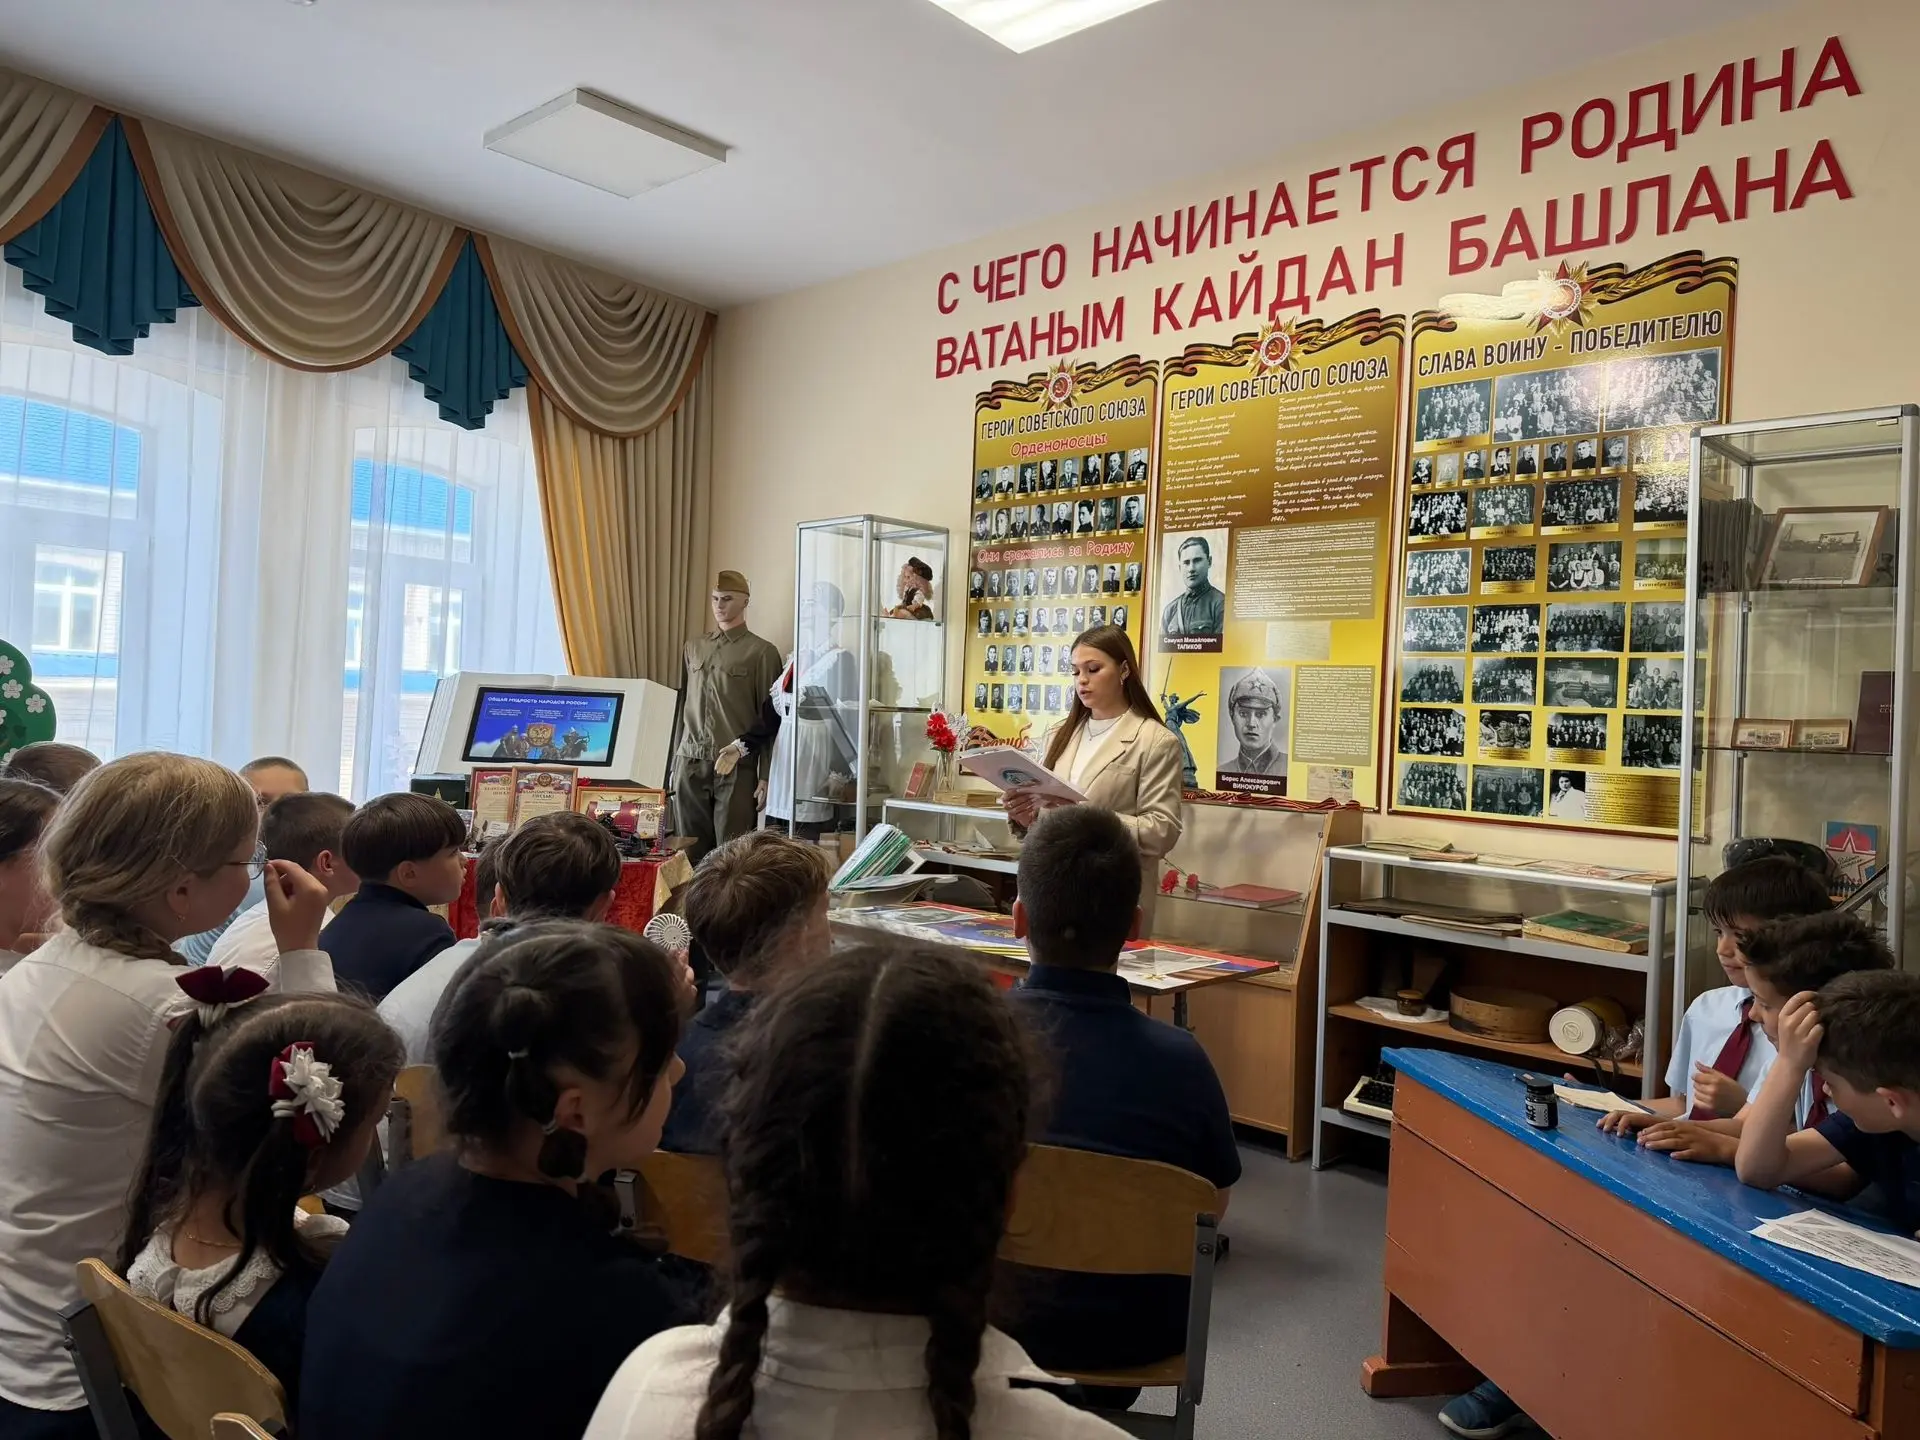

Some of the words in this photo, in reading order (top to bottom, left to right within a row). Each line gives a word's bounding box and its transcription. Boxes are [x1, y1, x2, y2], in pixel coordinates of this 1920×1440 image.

[939, 273, 959, 315] С
[974, 244, 1066, 303] ЧЕГО
[1093, 133, 1475, 277] НАЧИНАЕТСЯ
[1520, 37, 1861, 194] РОДИНА
[936, 296, 1124, 379] ВАТАНЫМ
[1154, 234, 1404, 335] КАЙДАН
[1449, 140, 1853, 275] БАШЛАНА
[1419, 350, 1477, 377] СЛАВА
[1484, 336, 1548, 367] ВОИНУ
[1570, 310, 1723, 354] ПОБЕДИТЕЛЮ
[1171, 385, 1215, 411] ГЕРОИ
[1220, 368, 1319, 402] СОВЕТСКОГО
[1327, 356, 1390, 386] СОЮЗА
[982, 422, 1014, 440] ГЕРОИ
[1018, 406, 1094, 434] СОВЕТСКОГО
[1100, 397, 1146, 421] СОЮЗА
[1010, 433, 1107, 457] Орденоносцы
[978, 549, 999, 563] Они
[1003, 546, 1064, 564] сражались
[1068, 546, 1082, 557] за
[1086, 541, 1134, 558] Родину
[1232, 783, 1269, 792] ВИНОКУРОВ
